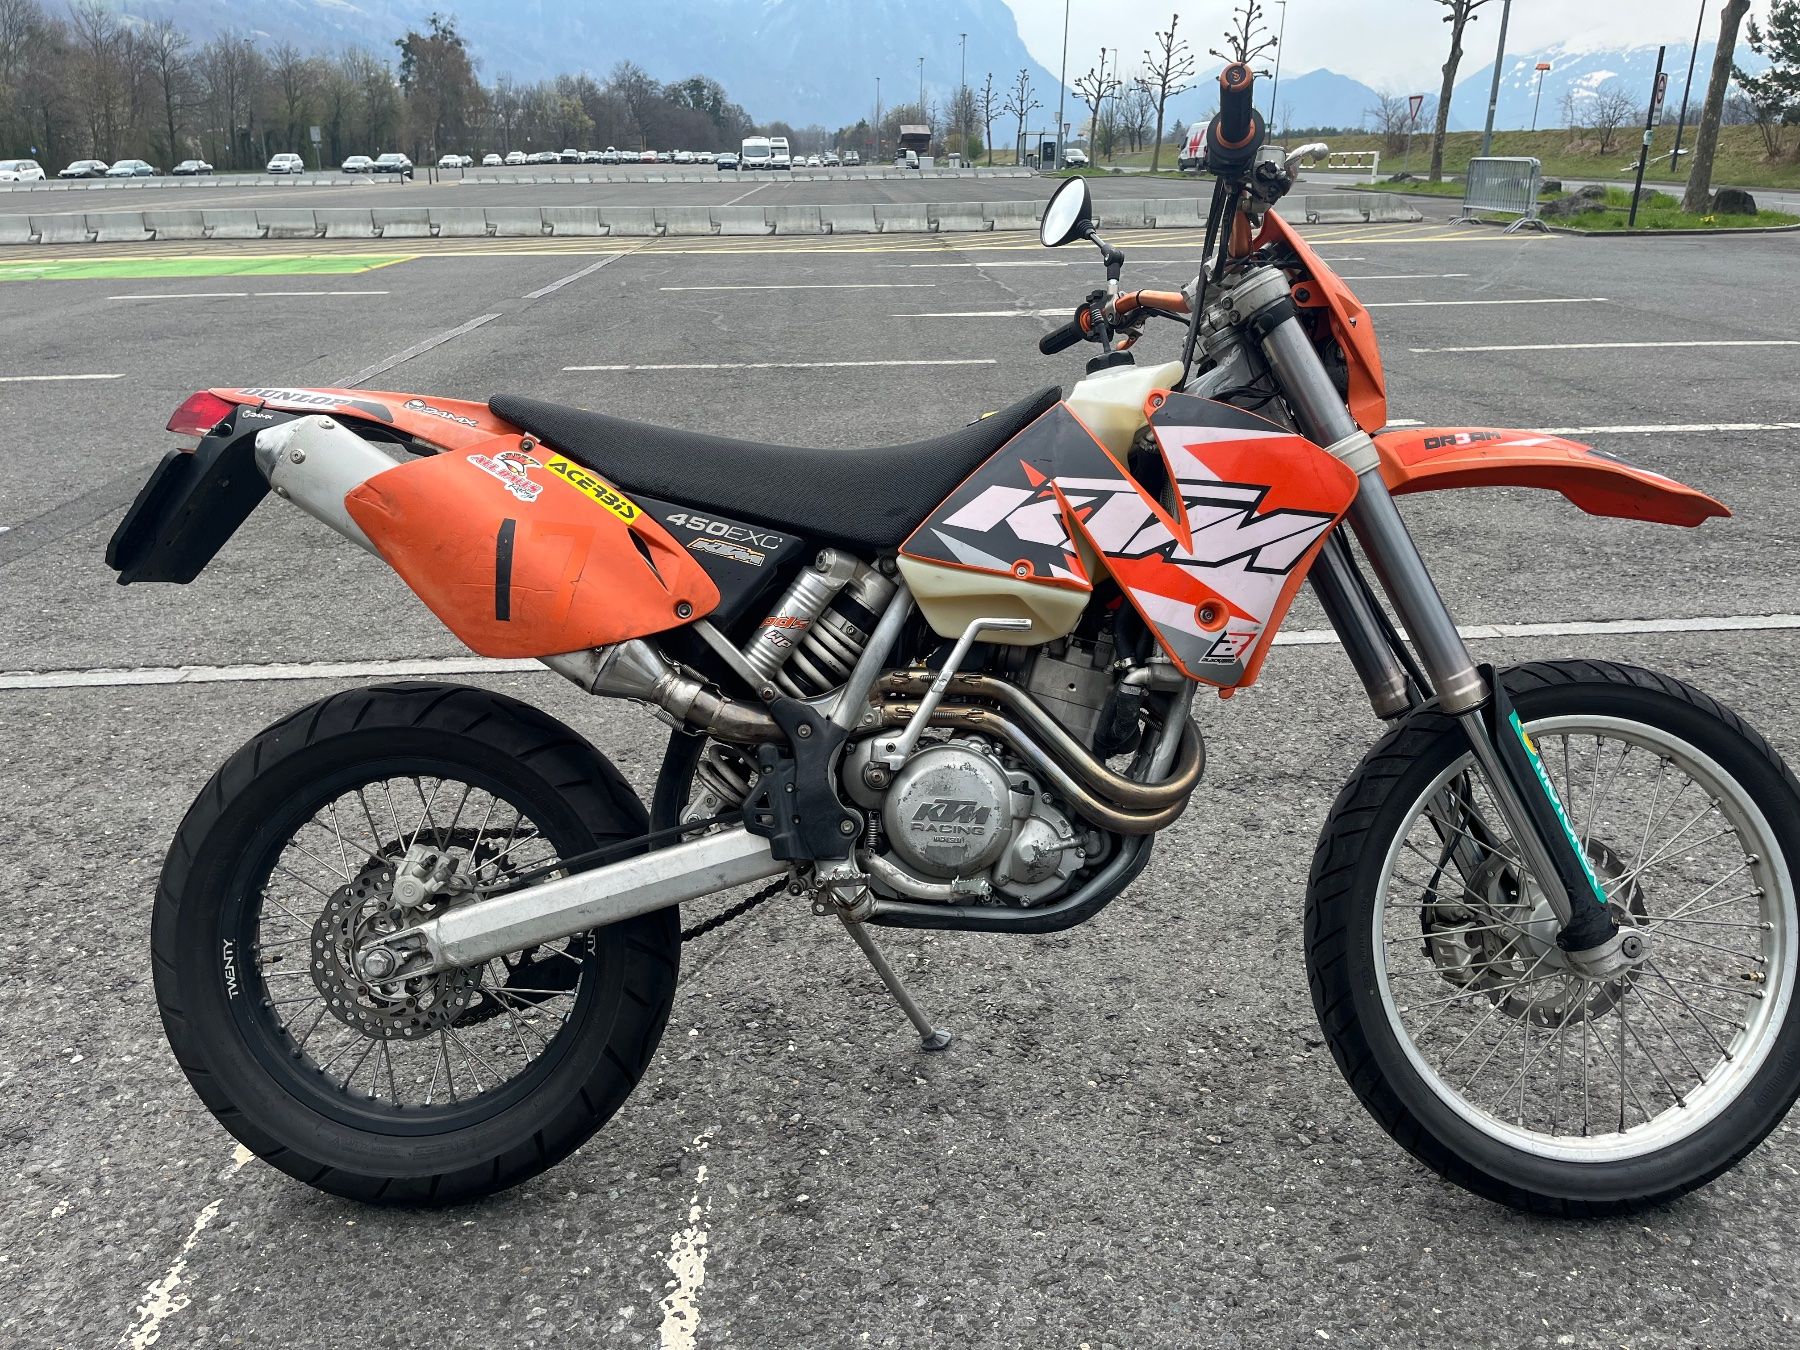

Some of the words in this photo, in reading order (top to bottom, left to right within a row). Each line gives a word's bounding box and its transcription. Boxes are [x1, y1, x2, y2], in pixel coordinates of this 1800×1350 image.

[240, 388, 354, 406] DUNLOP
[423, 406, 480, 428] 24MX
[1424, 431, 1502, 451] DR3AM
[665, 513, 783, 550] 450EXC
[940, 475, 1334, 575] KTM
[686, 538, 766, 567] KTM
[764, 629, 794, 649] WP
[911, 798, 992, 825] KTM
[910, 821, 985, 836] RACING
[223, 938, 239, 1000] TWENTY
